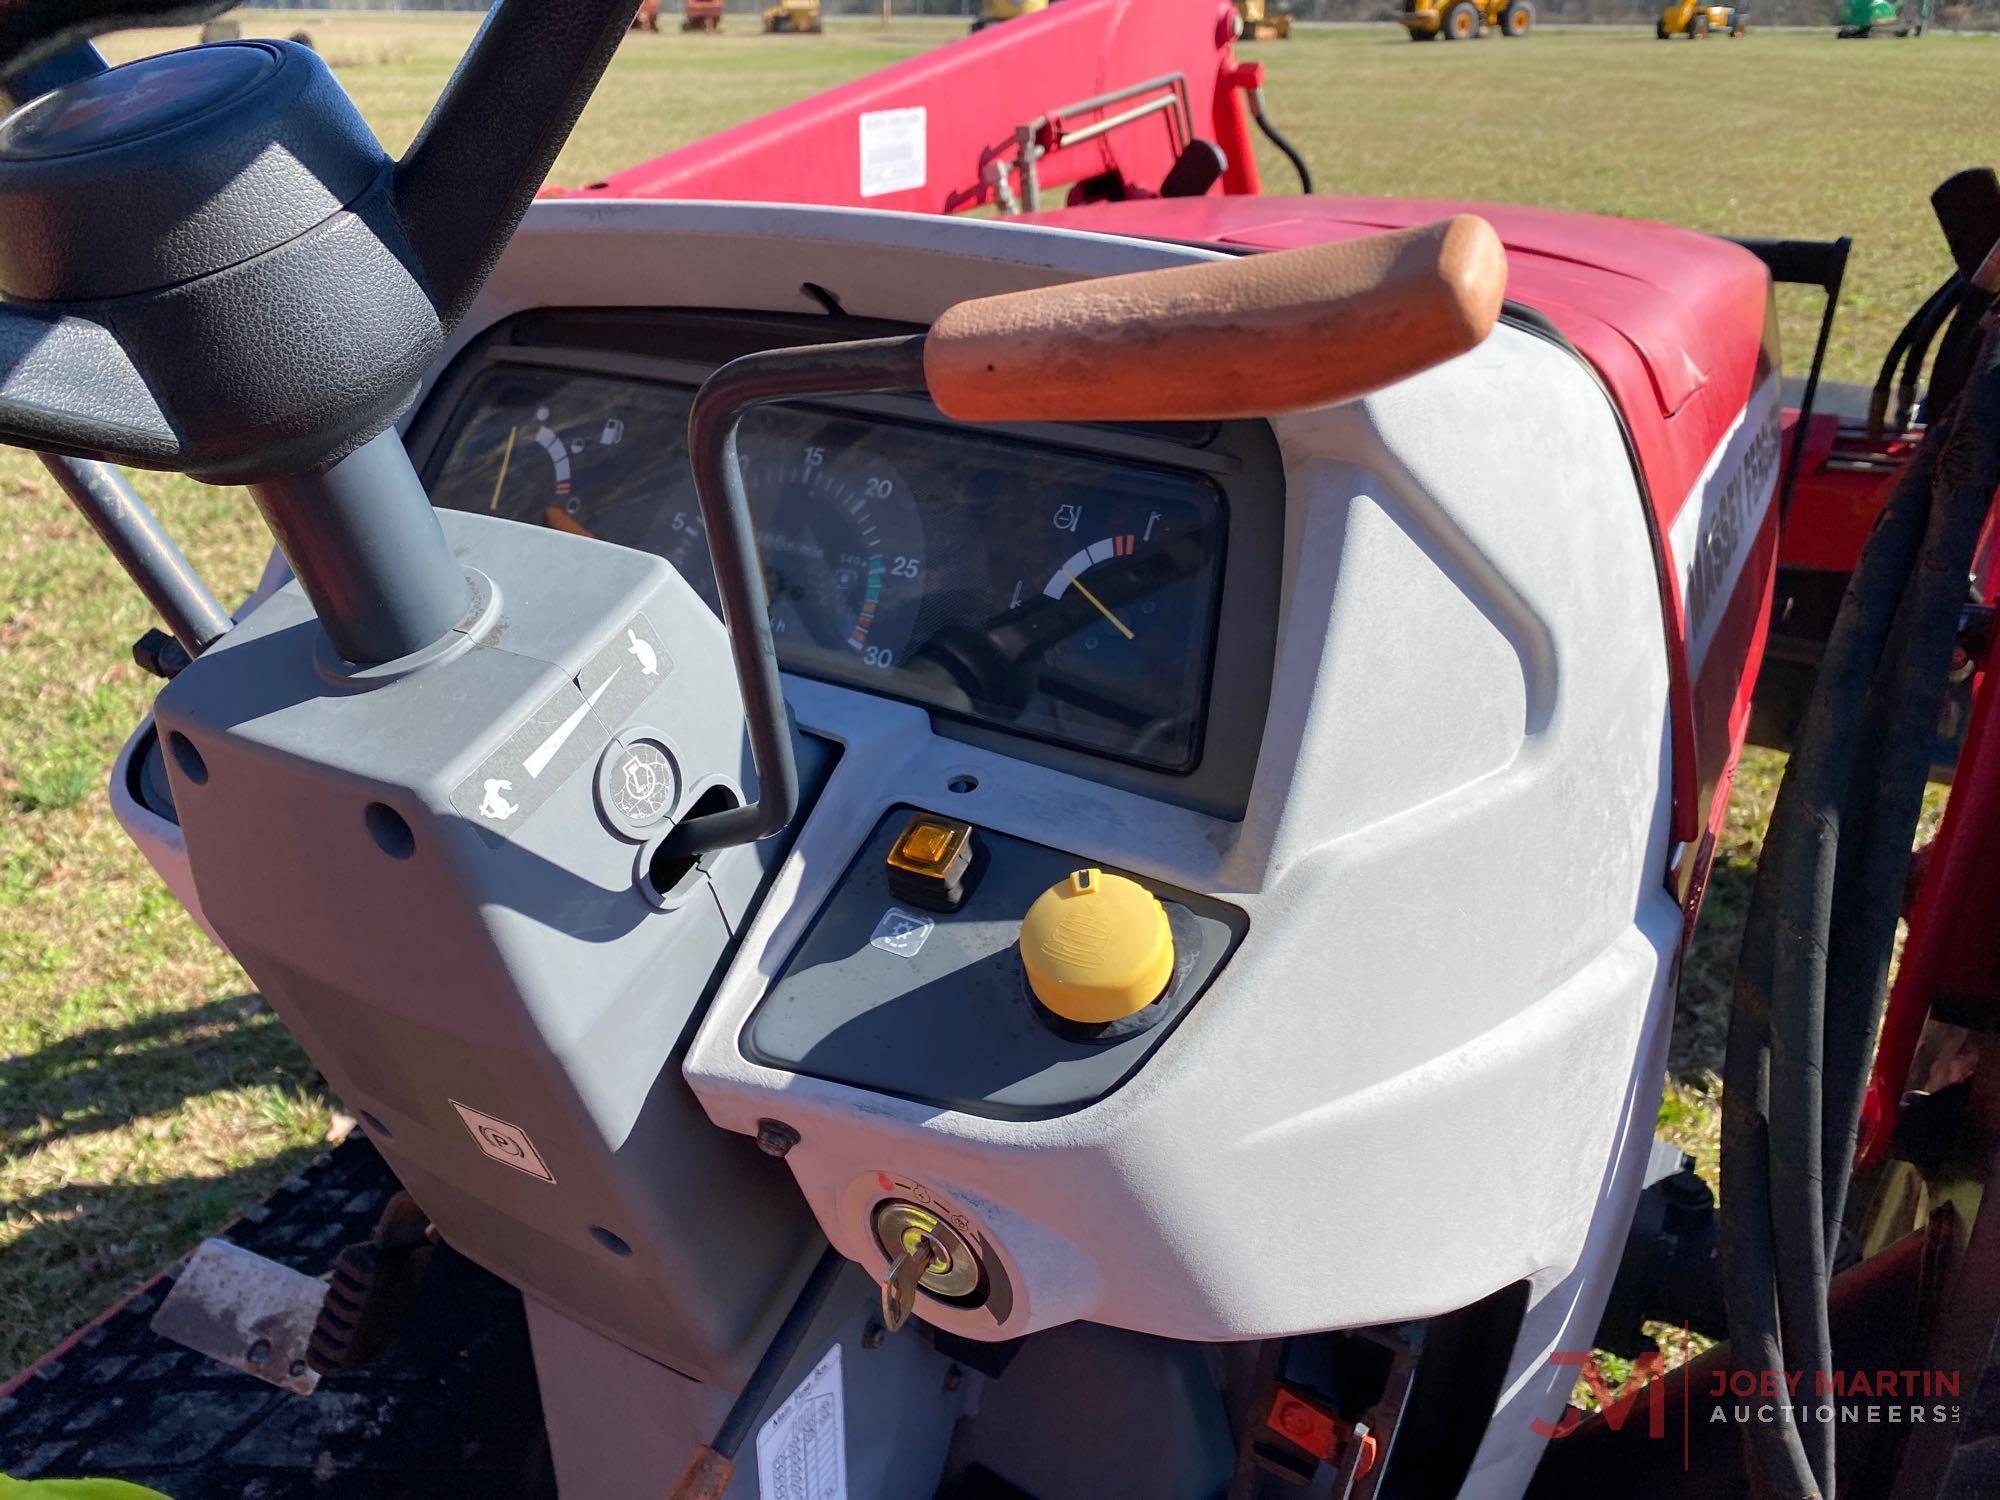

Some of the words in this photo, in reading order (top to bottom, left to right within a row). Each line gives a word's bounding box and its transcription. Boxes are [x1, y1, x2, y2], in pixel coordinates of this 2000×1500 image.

[804, 447, 825, 466] 15
[864, 476, 893, 499] 20
[671, 511, 688, 532] 5
[890, 555, 920, 579] 25
[862, 645, 893, 669] 30
